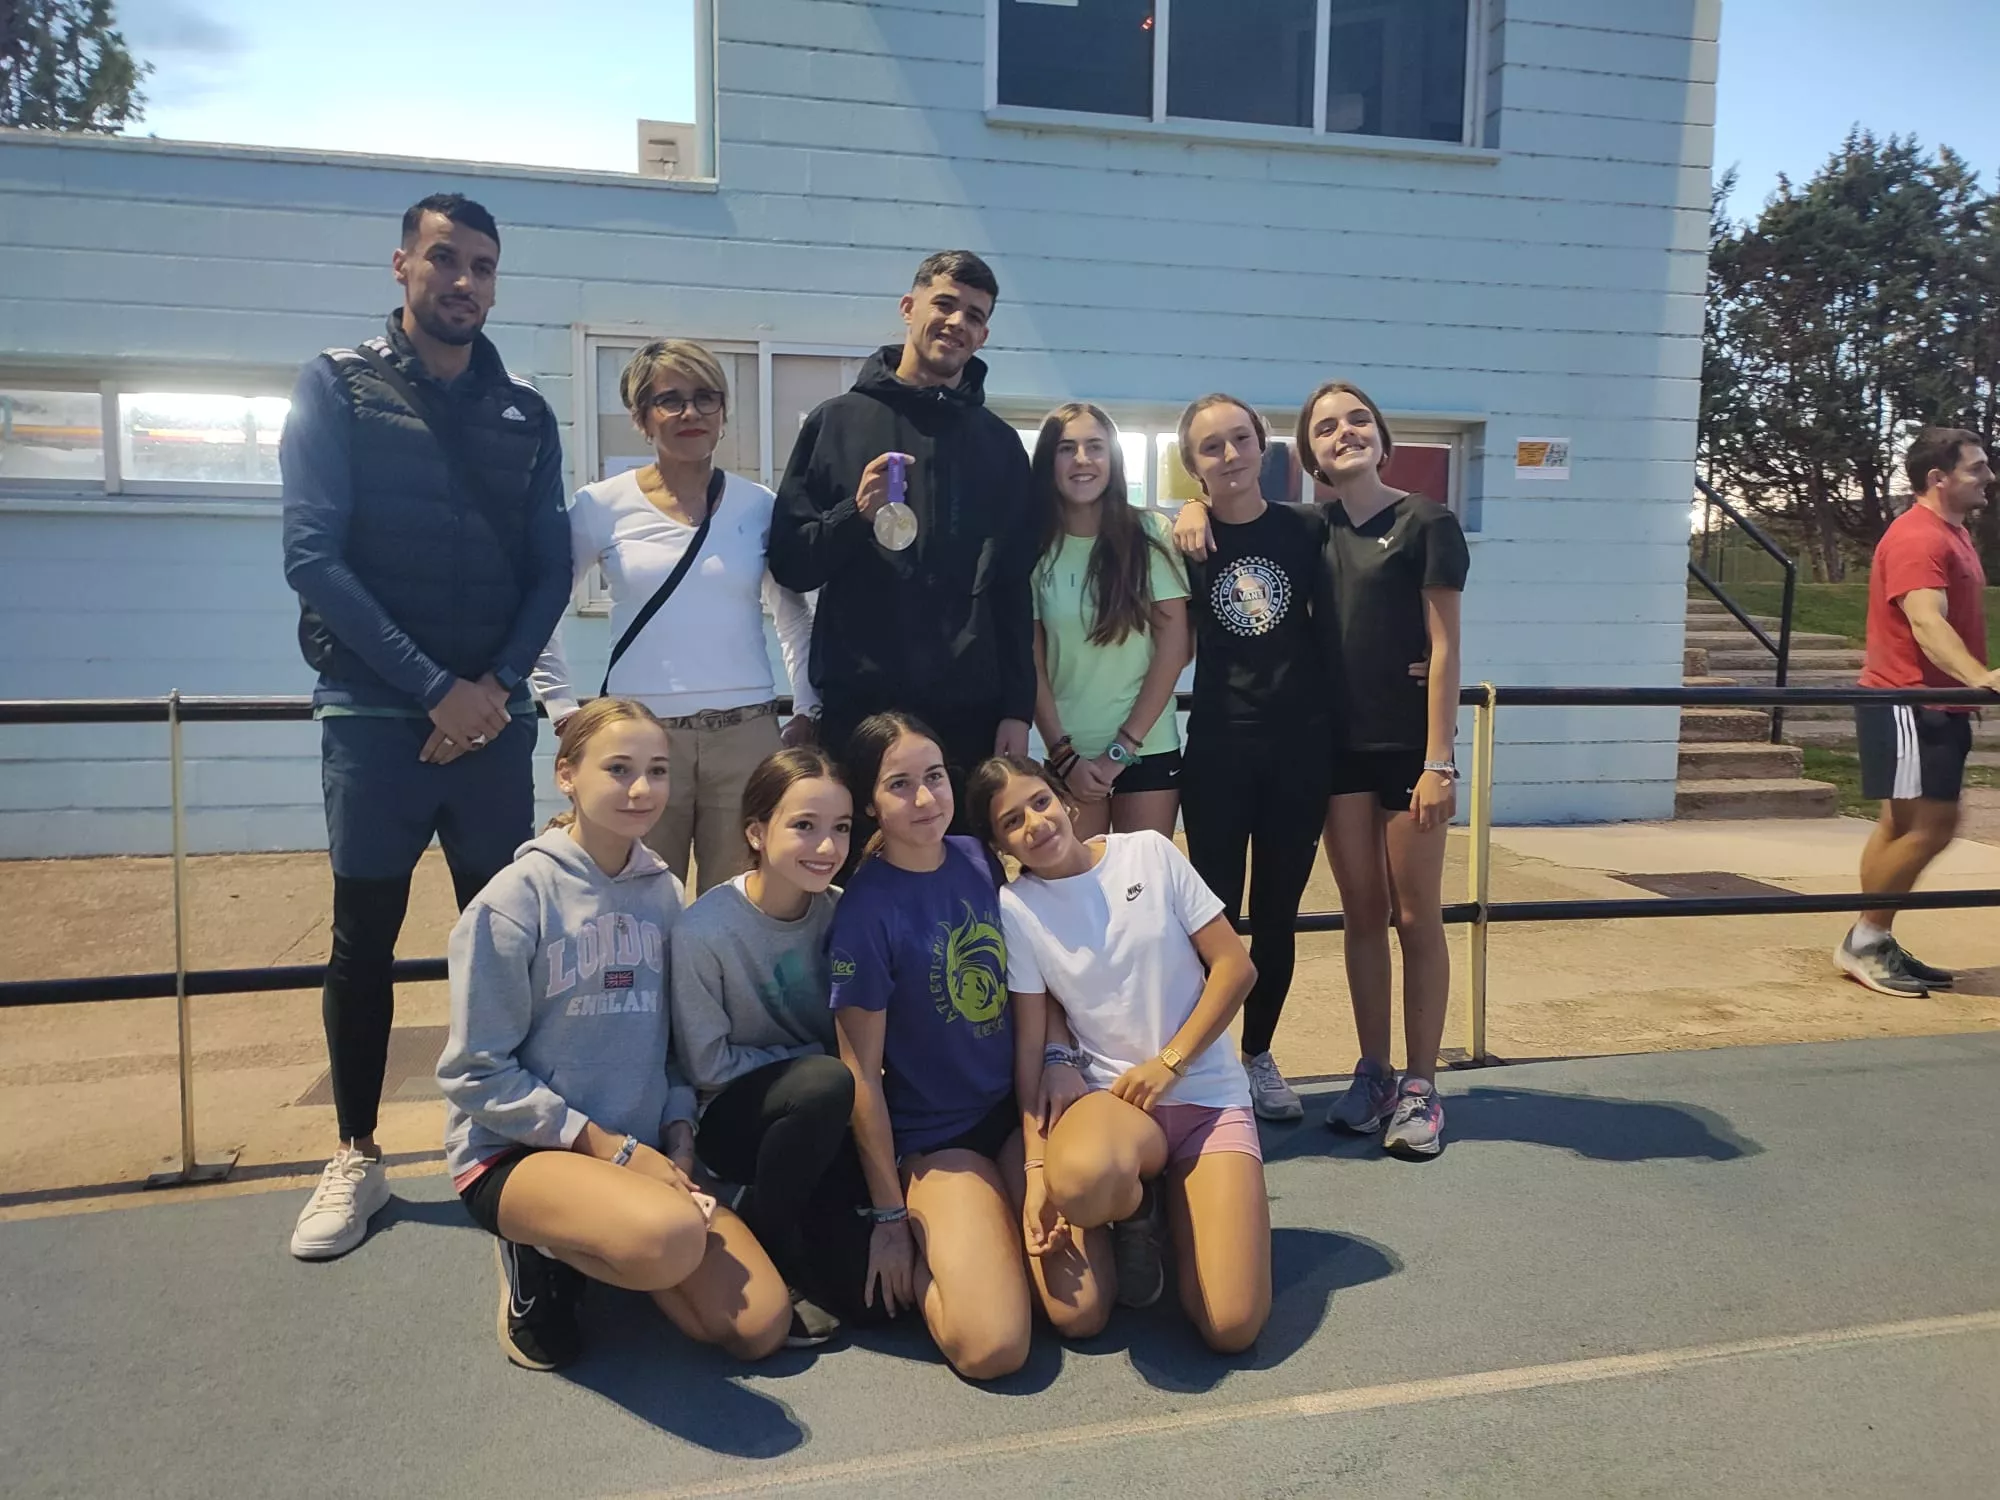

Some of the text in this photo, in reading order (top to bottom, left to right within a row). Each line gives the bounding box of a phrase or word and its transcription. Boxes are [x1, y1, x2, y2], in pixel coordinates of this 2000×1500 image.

[1238, 589, 1265, 601] VANS
[545, 911, 662, 998] LONDO
[565, 990, 658, 1016] ENGLAN
